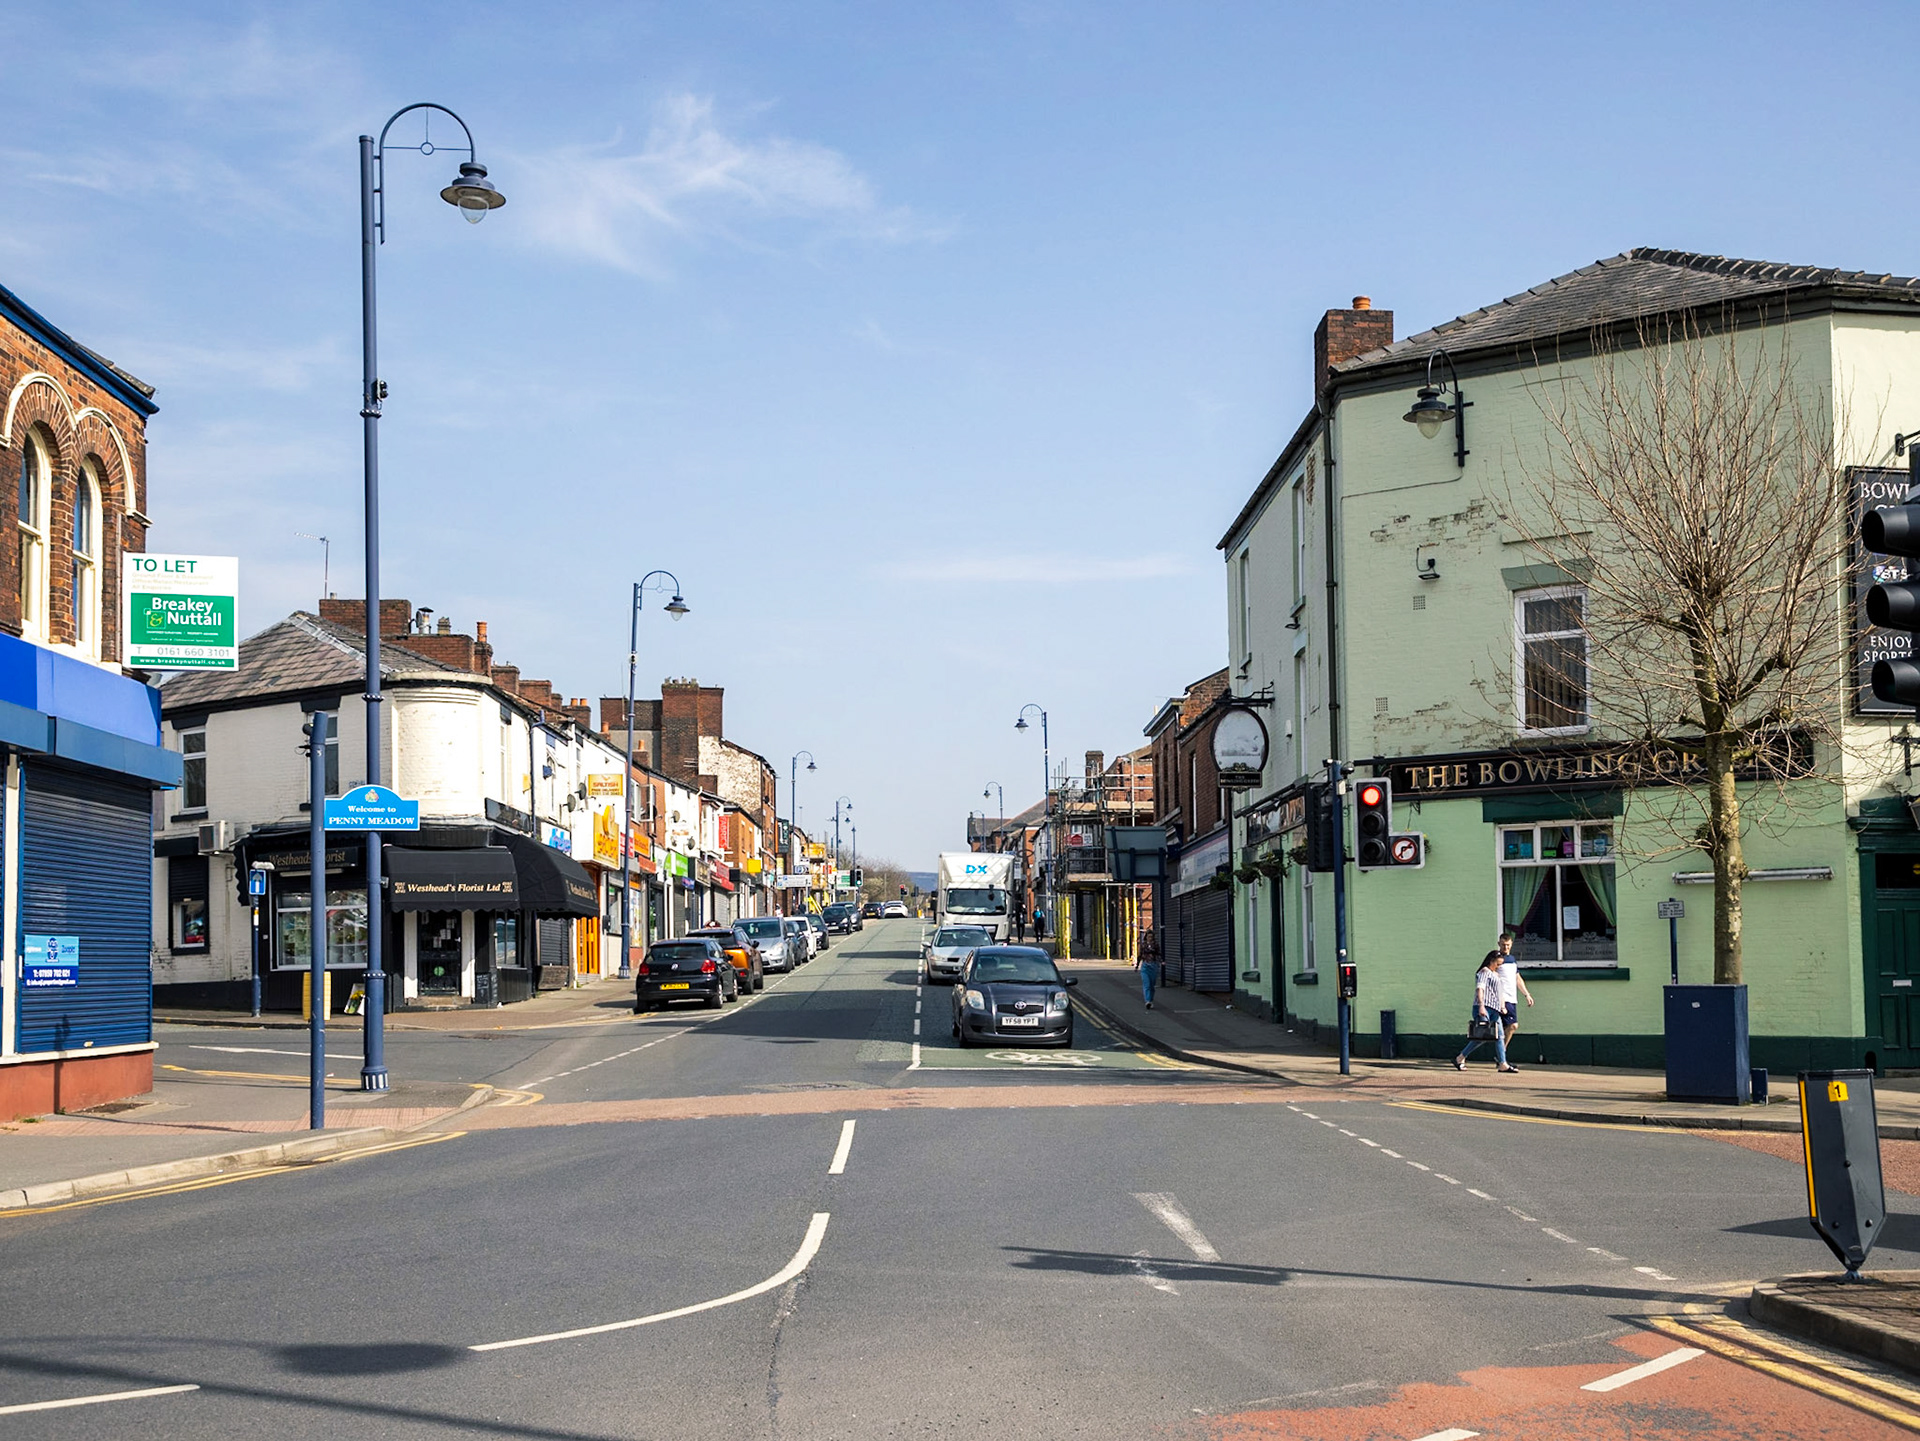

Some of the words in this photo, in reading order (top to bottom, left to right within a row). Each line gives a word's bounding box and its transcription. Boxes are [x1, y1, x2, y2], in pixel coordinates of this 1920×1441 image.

[132, 558, 157, 572] TO
[164, 560, 198, 573] LET
[152, 597, 214, 616] Breakey
[167, 611, 222, 626] Nuttall
[1870, 635, 1912, 650] ENJOY
[157, 647, 180, 656] 0161
[184, 648, 204, 656] 660
[207, 649, 230, 657] 3101
[1405, 763, 1469, 790] THE
[1478, 750, 1640, 786] BOWLING
[348, 805, 386, 813] Welcome
[328, 816, 365, 825] PENNY
[367, 816, 415, 825] MEADOW
[965, 864, 988, 875] DX
[407, 883, 456, 893] Westhead's
[457, 883, 484, 892] Florist
[486, 883, 501, 892] Ltd
[1834, 1084, 1841, 1098] 1
